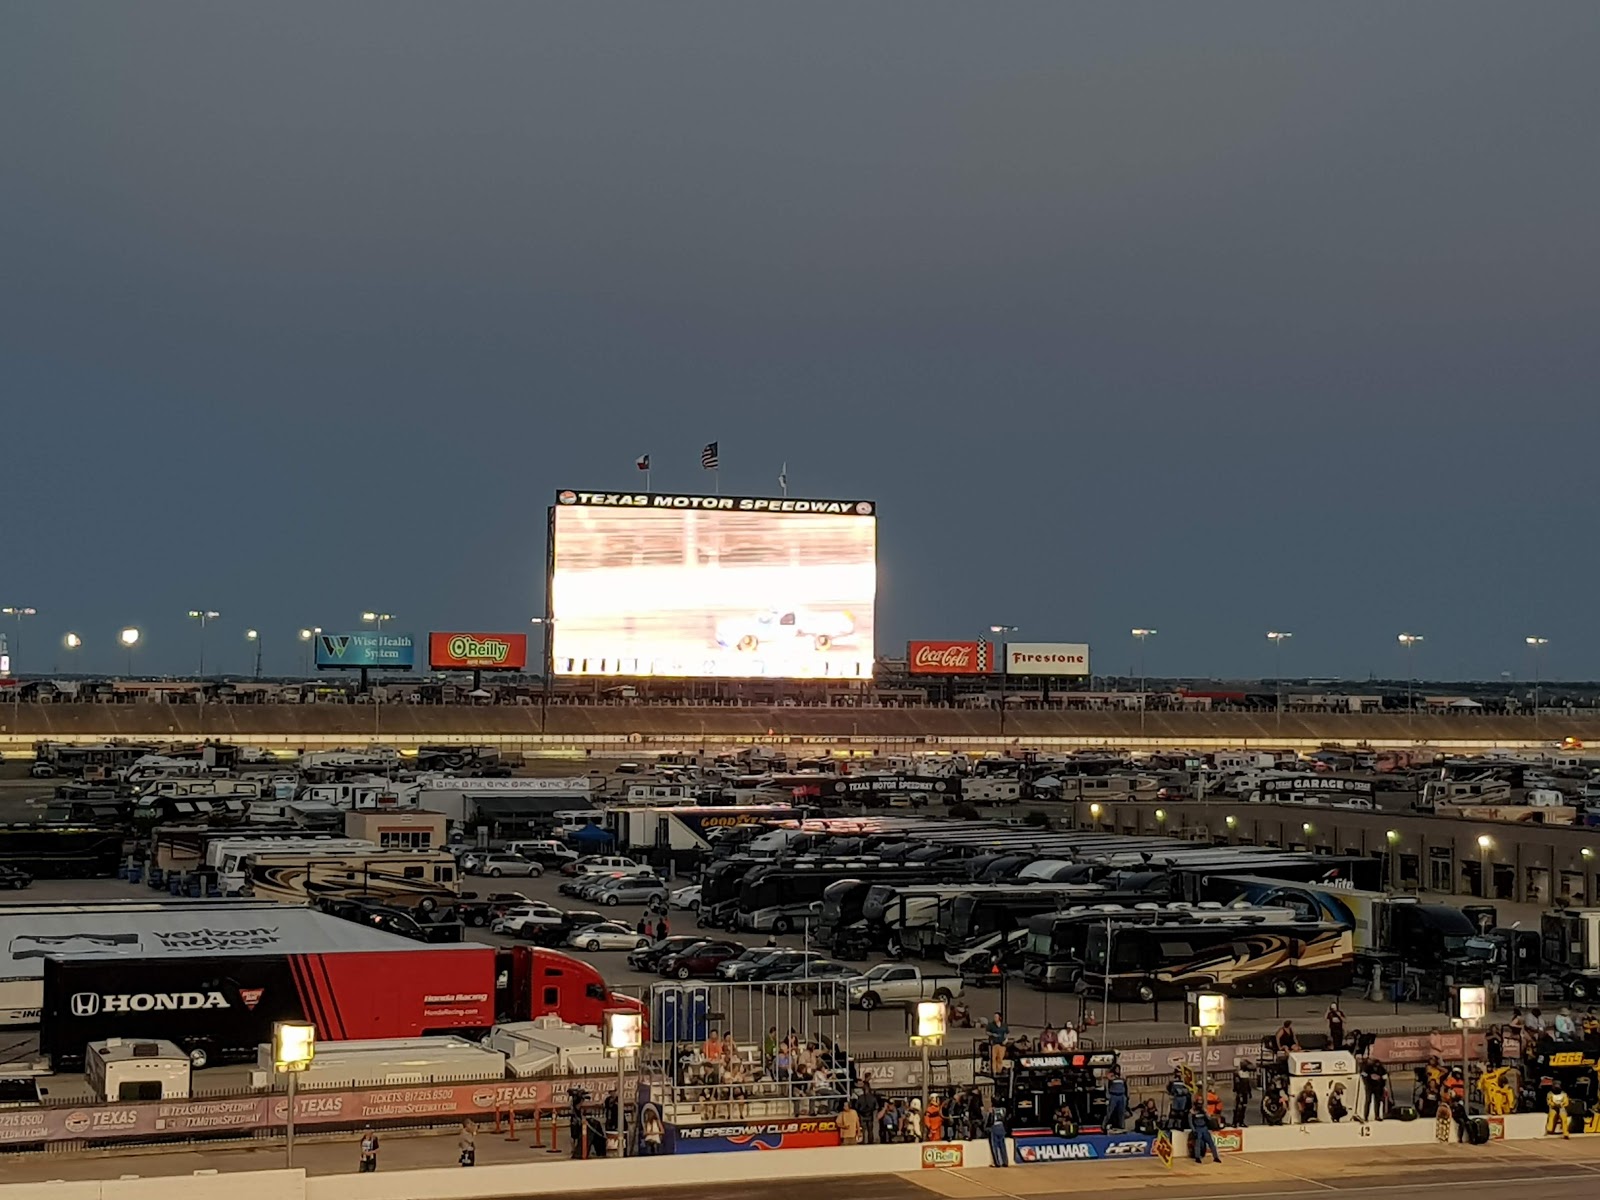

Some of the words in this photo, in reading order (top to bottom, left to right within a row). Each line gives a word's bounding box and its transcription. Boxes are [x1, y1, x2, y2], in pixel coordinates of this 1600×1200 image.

[578, 493, 649, 506] TEXAS
[653, 496, 734, 509] MOTOR
[739, 499, 853, 513] SPEEDWAY
[353, 636, 377, 647] Wise
[379, 636, 412, 647] Health
[450, 636, 509, 660] O'Reilly
[1012, 652, 1084, 664] Firestone
[849, 782, 870, 792] TEXAS
[872, 782, 897, 790] MOTOR
[899, 782, 934, 791] SPEEDWAY
[1294, 779, 1344, 789] GARAGE
[701, 815, 767, 827] GOODYEA
[153, 928, 272, 939] verizon
[160, 937, 281, 948] indycar
[102, 991, 231, 1012] HONDA
[1030, 1056, 1064, 1066] HALMAR
[1187, 1050, 1220, 1062] TEAS
[496, 1085, 537, 1101] TEXAS
[300, 1097, 343, 1112] TEXAS
[92, 1110, 138, 1125] TEXAS
[680, 1127, 701, 1139] THE
[703, 1124, 766, 1138] SPEEDWAY
[767, 1123, 798, 1134] CLUB
[799, 1121, 818, 1132] PIT
[818, 1121, 838, 1131] BO
[1036, 1143, 1089, 1159] HALMAR
